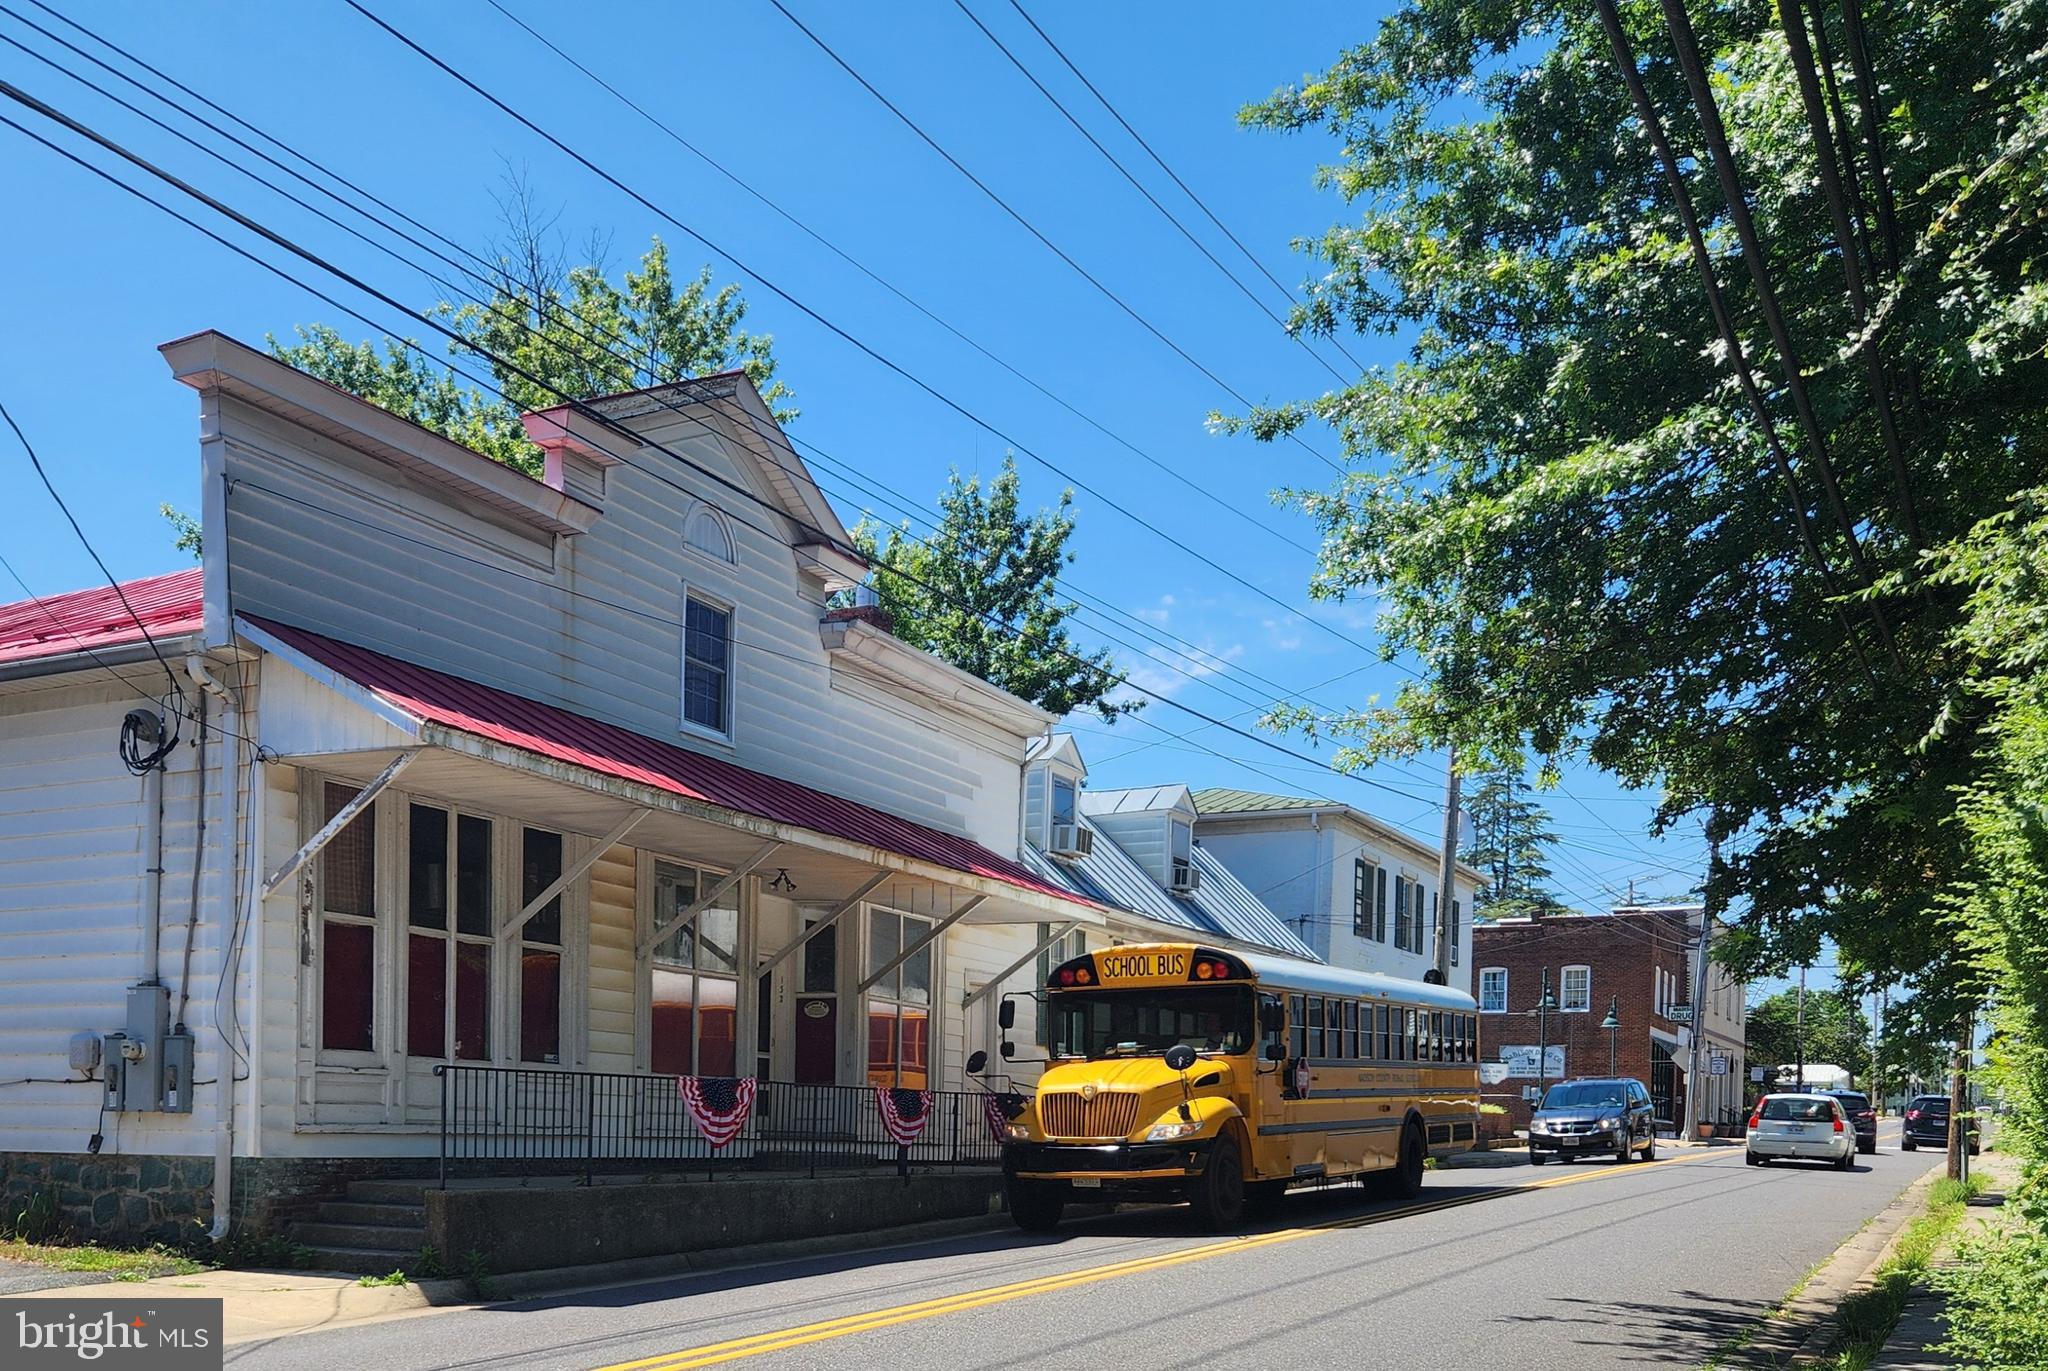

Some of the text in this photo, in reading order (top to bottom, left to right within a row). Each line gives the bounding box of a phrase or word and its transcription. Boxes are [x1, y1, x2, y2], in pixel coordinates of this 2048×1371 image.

[1104, 954, 1184, 977] SCHOOL BUS
[1188, 1151, 1197, 1164] 7
